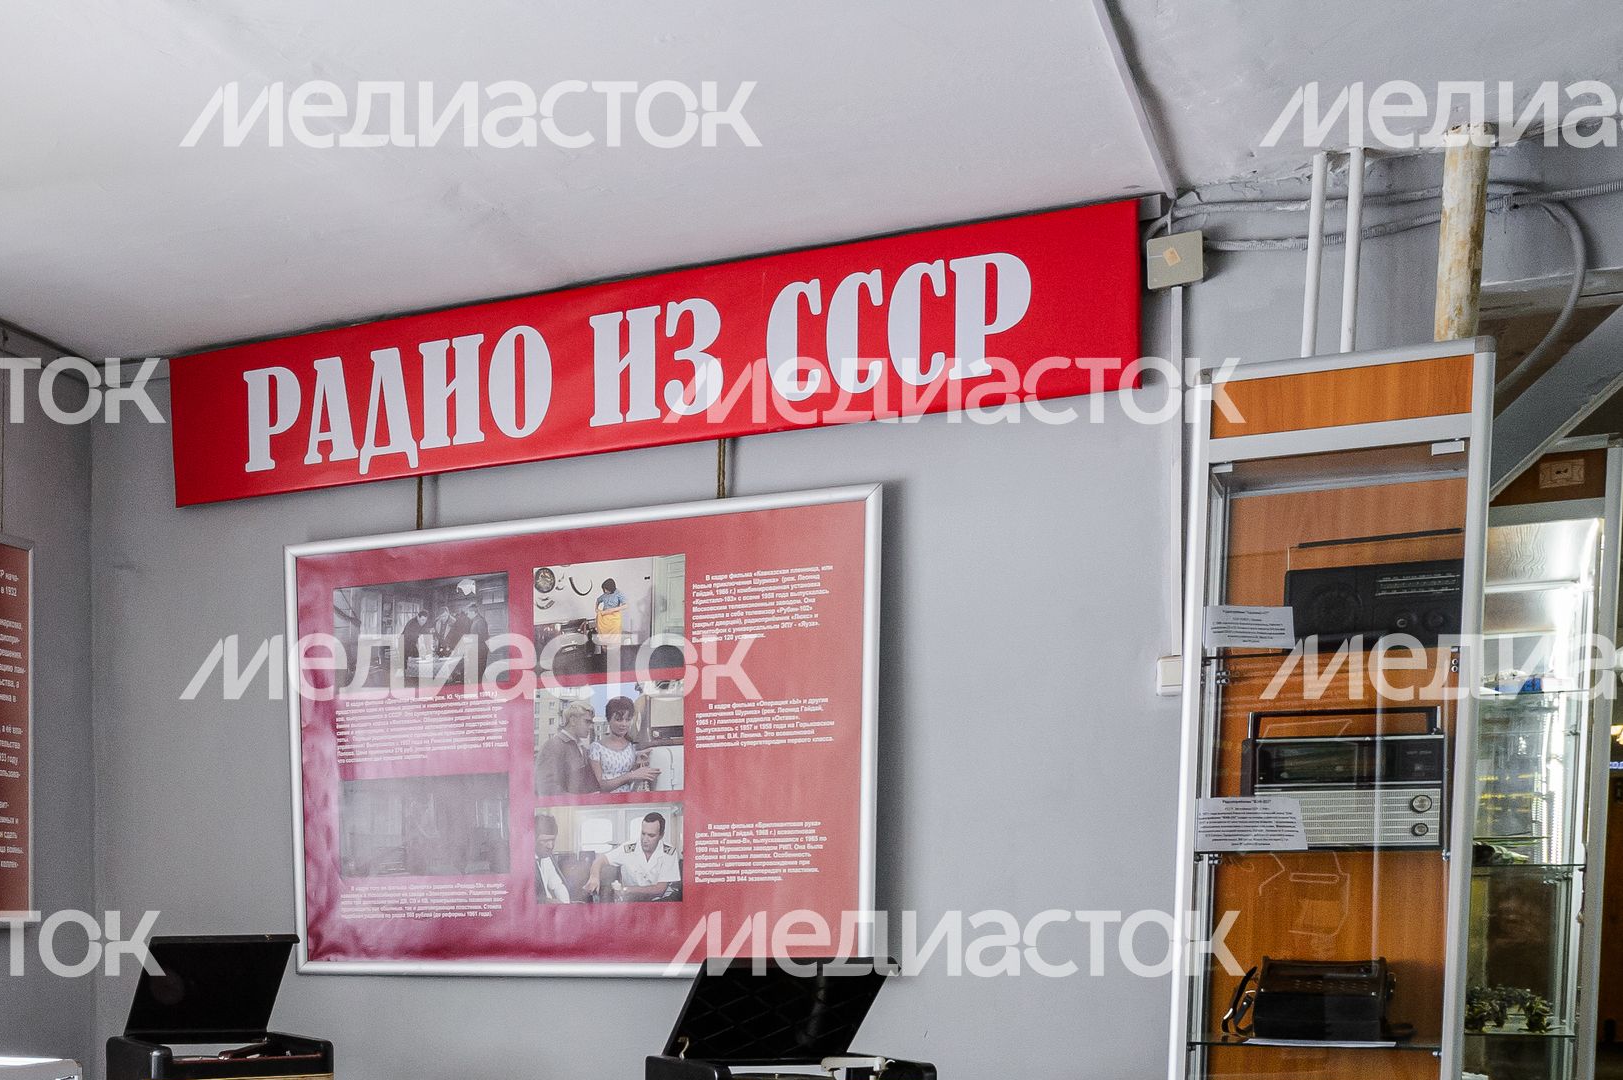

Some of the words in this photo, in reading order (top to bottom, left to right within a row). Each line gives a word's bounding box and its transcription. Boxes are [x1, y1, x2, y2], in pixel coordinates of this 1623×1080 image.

[243, 324, 553, 476] РАДИО
[588, 296, 724, 429] ИЗ
[765, 251, 1033, 402] СССР
